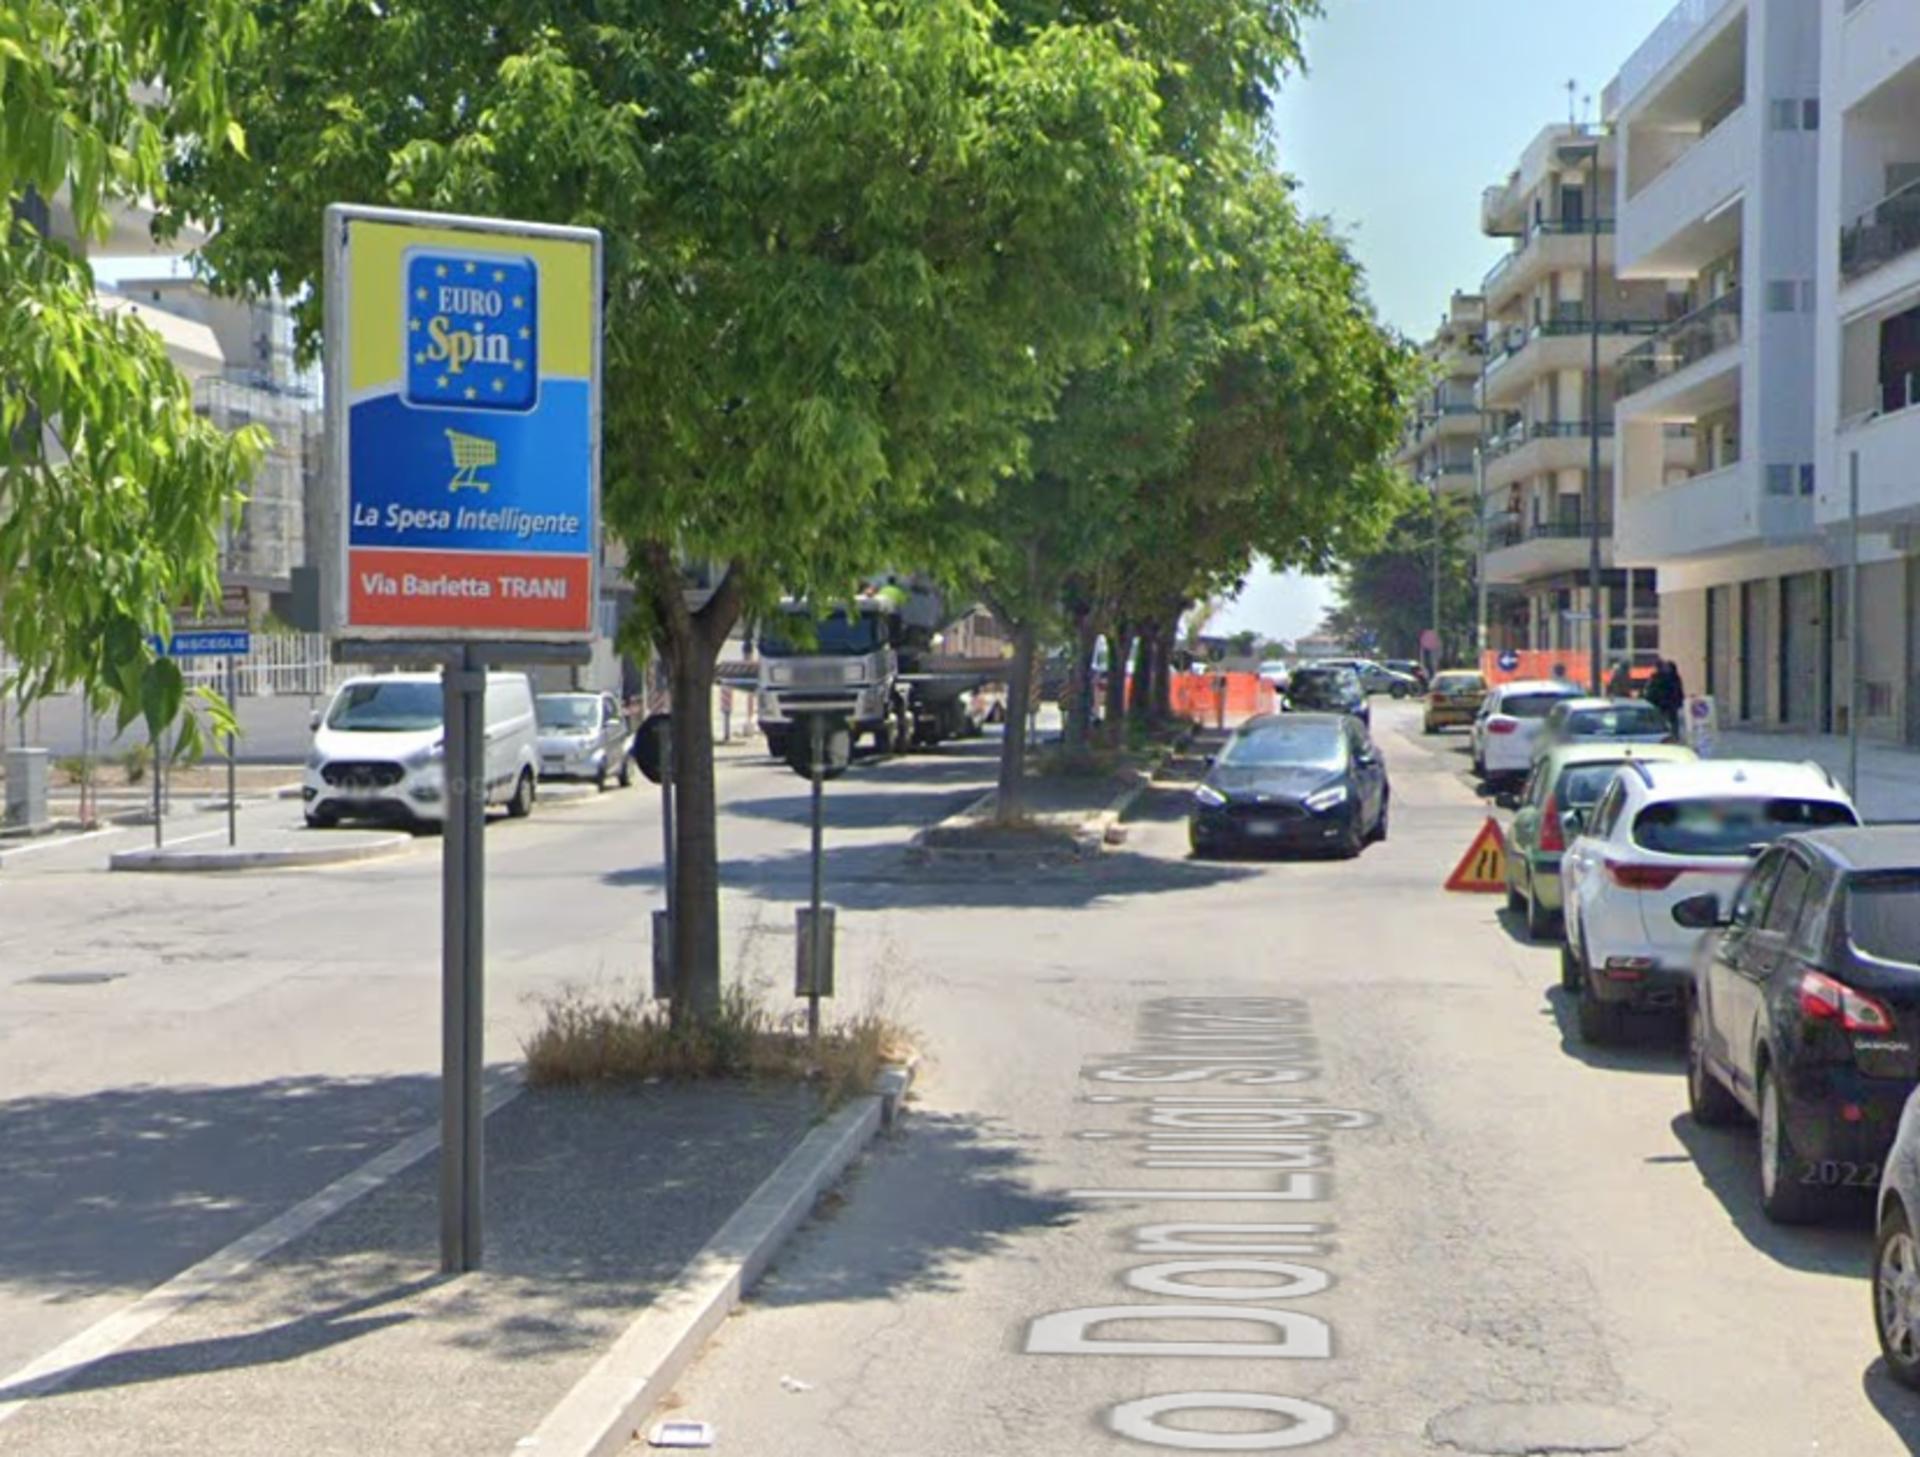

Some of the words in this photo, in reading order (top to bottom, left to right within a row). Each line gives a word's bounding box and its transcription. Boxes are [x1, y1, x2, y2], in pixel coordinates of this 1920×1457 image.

[437, 286, 503, 316] EURO
[427, 315, 510, 374] Spin
[353, 503, 379, 526] La
[385, 503, 450, 533] Spesa
[456, 506, 580, 539] Intelligente
[361, 573, 396, 596] Via
[402, 574, 491, 598] Barletta
[498, 576, 567, 599] TRANI
